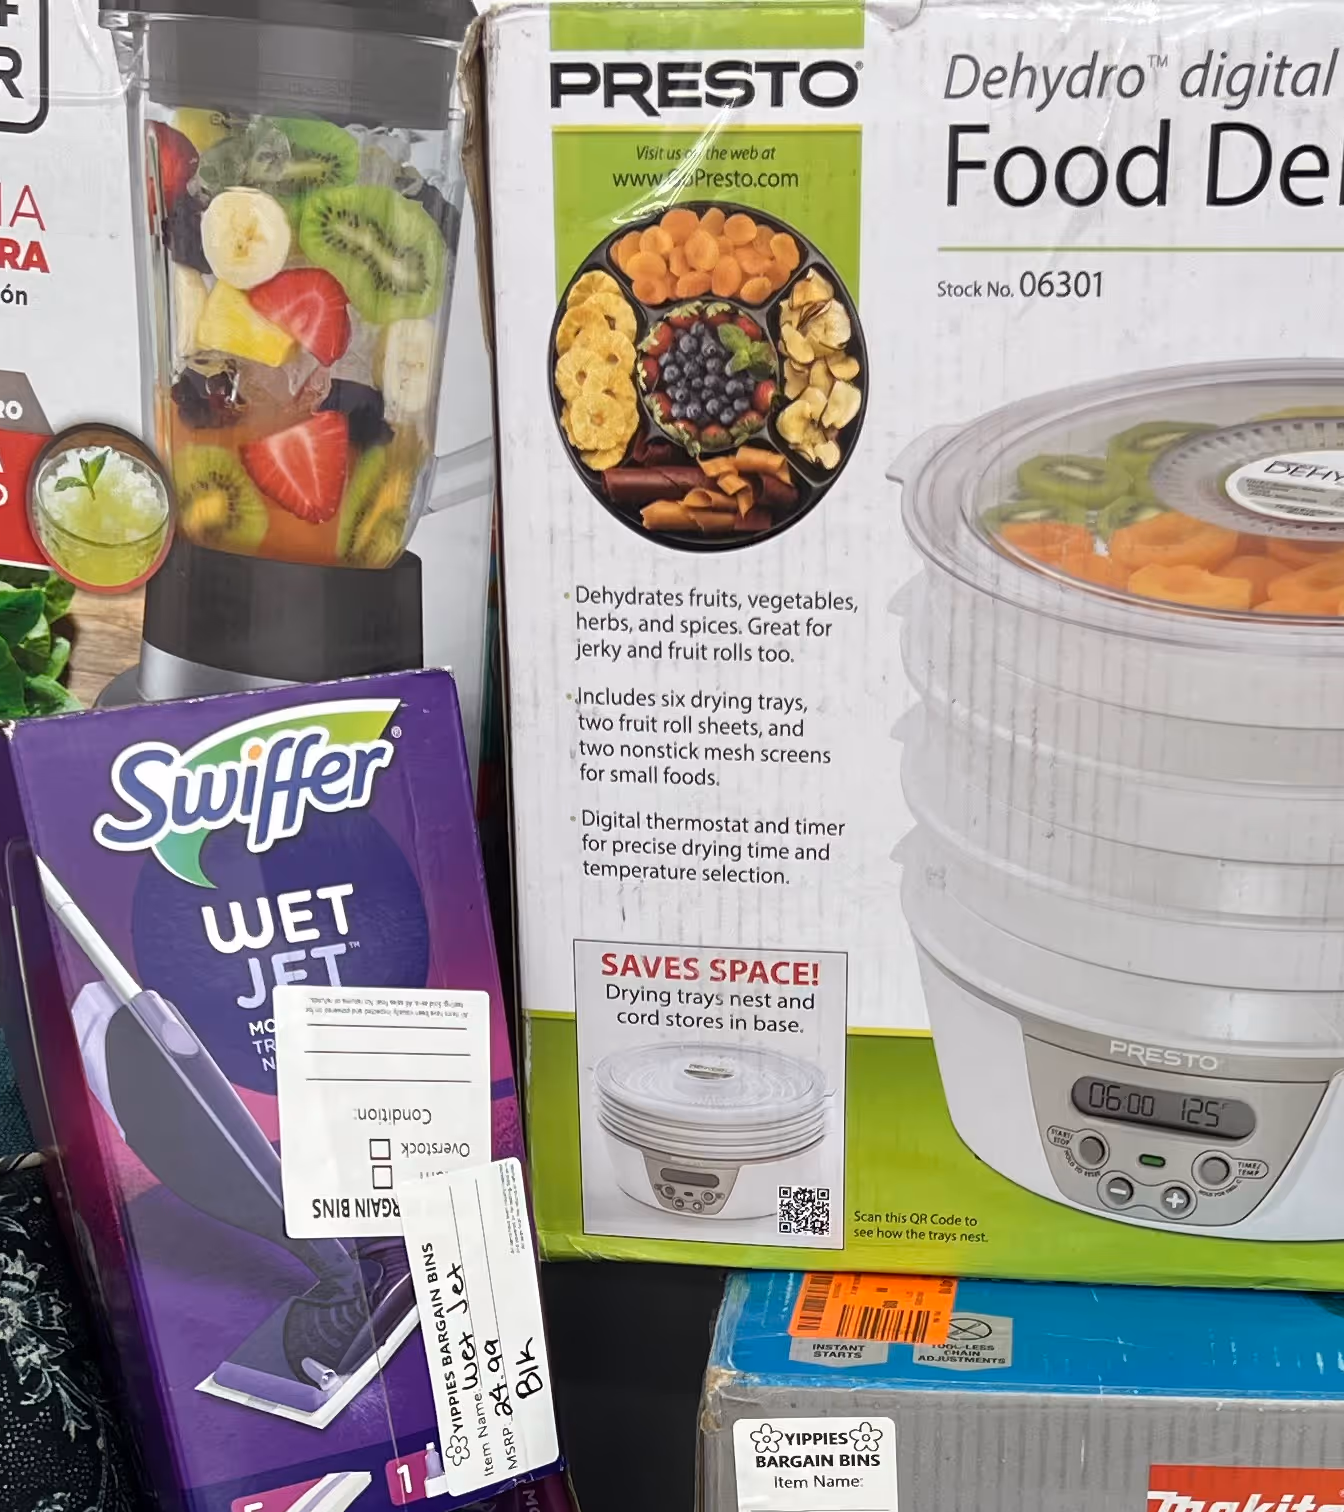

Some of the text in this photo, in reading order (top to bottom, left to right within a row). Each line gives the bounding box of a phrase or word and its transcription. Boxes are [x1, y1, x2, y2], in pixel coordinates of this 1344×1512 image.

[550, 60, 858, 118] PRESTO
[1180, 50, 1335, 110] digital
[946, 118, 1172, 209] Food
[937, 270, 1104, 300] Stock No. 06301
[576, 585, 858, 613] Dehydrates fruits, vegetables,
[576, 611, 832, 637] herbs, and spices. Great for
[100, 732, 388, 848] Swiffer
[201, 884, 354, 954] WET
[601, 953, 819, 986] SAVES SPACE!
[605, 984, 815, 1010] Drying trays nest and
[353, 1108, 432, 1124] Condition:
[401, 1142, 471, 1158] Overstock
[422, 1243, 463, 1433] YIPPIES BARGAIN BINS
